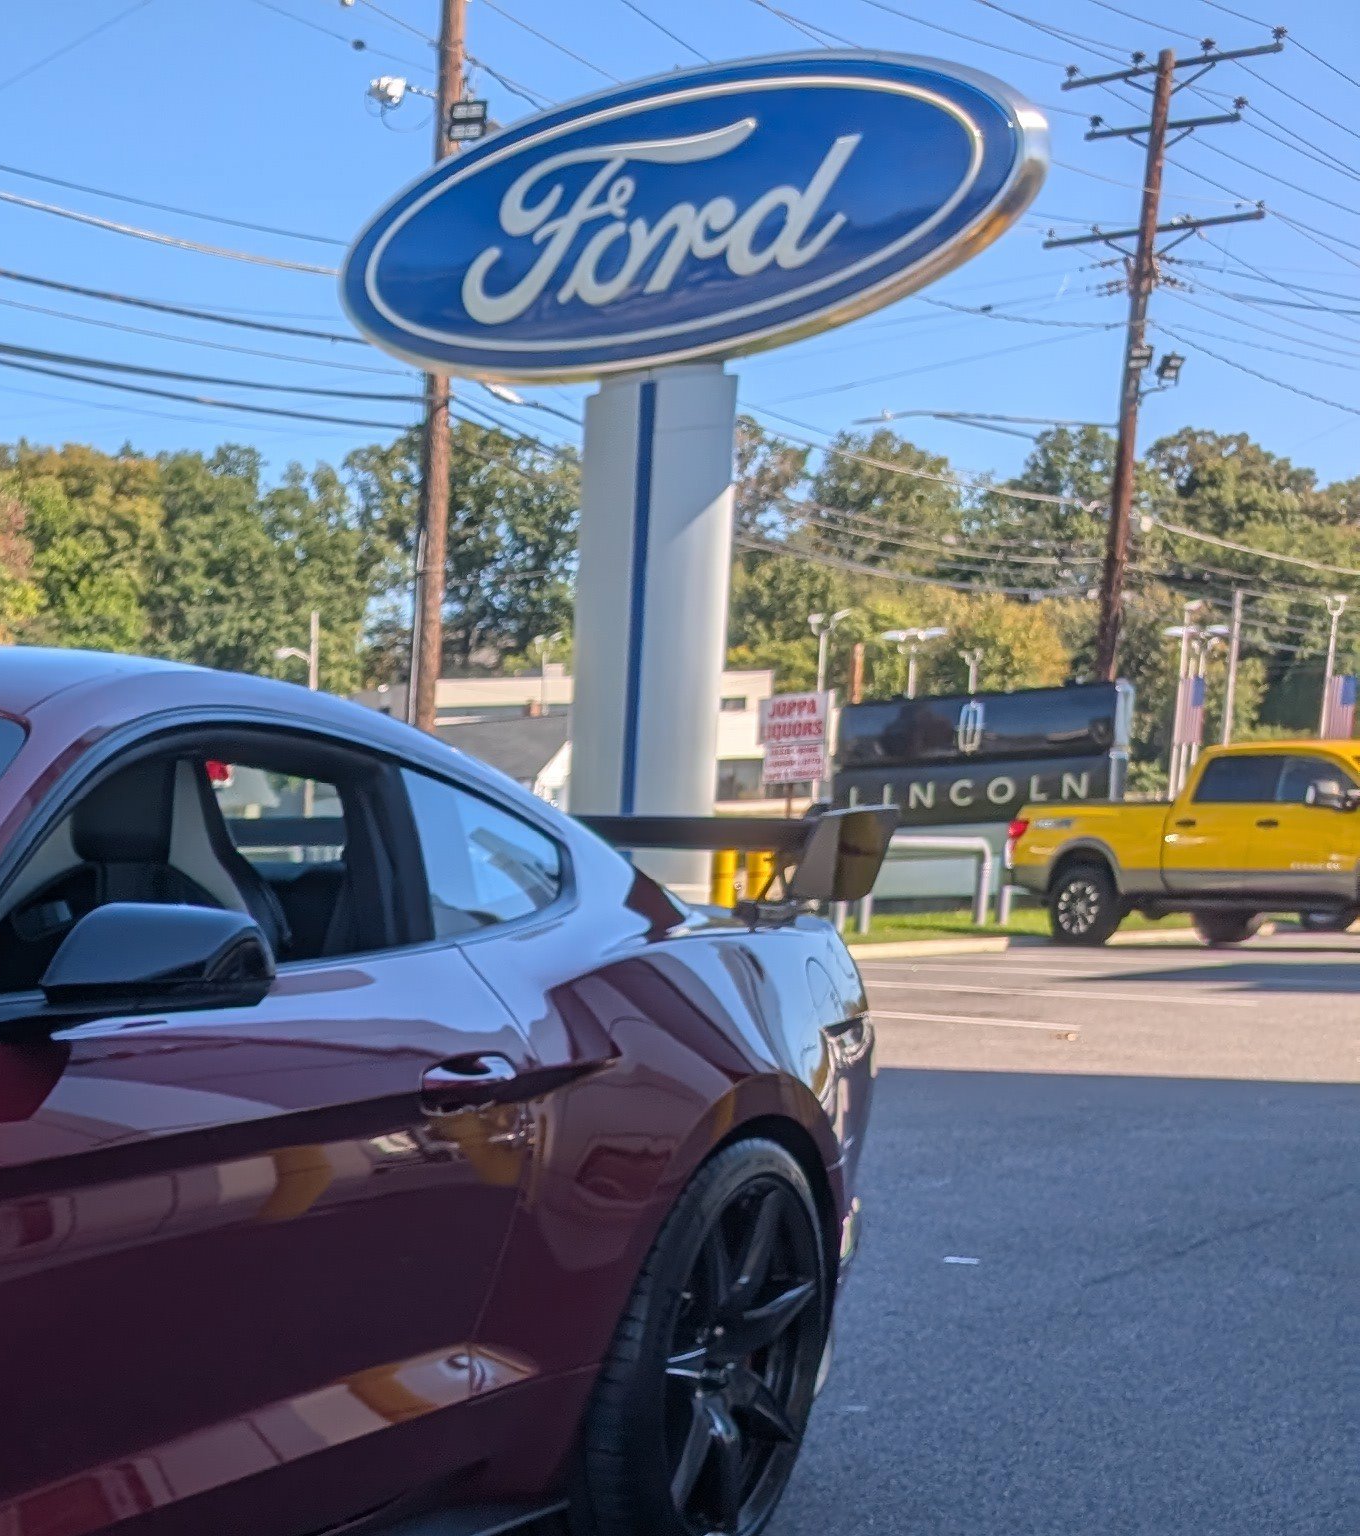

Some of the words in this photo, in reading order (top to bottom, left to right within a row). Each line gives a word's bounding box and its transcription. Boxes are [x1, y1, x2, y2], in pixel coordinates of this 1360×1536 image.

[462, 117, 863, 326] Ford
[768, 698, 817, 718] JOPPA
[849, 772, 1090, 809] LINCOLN
